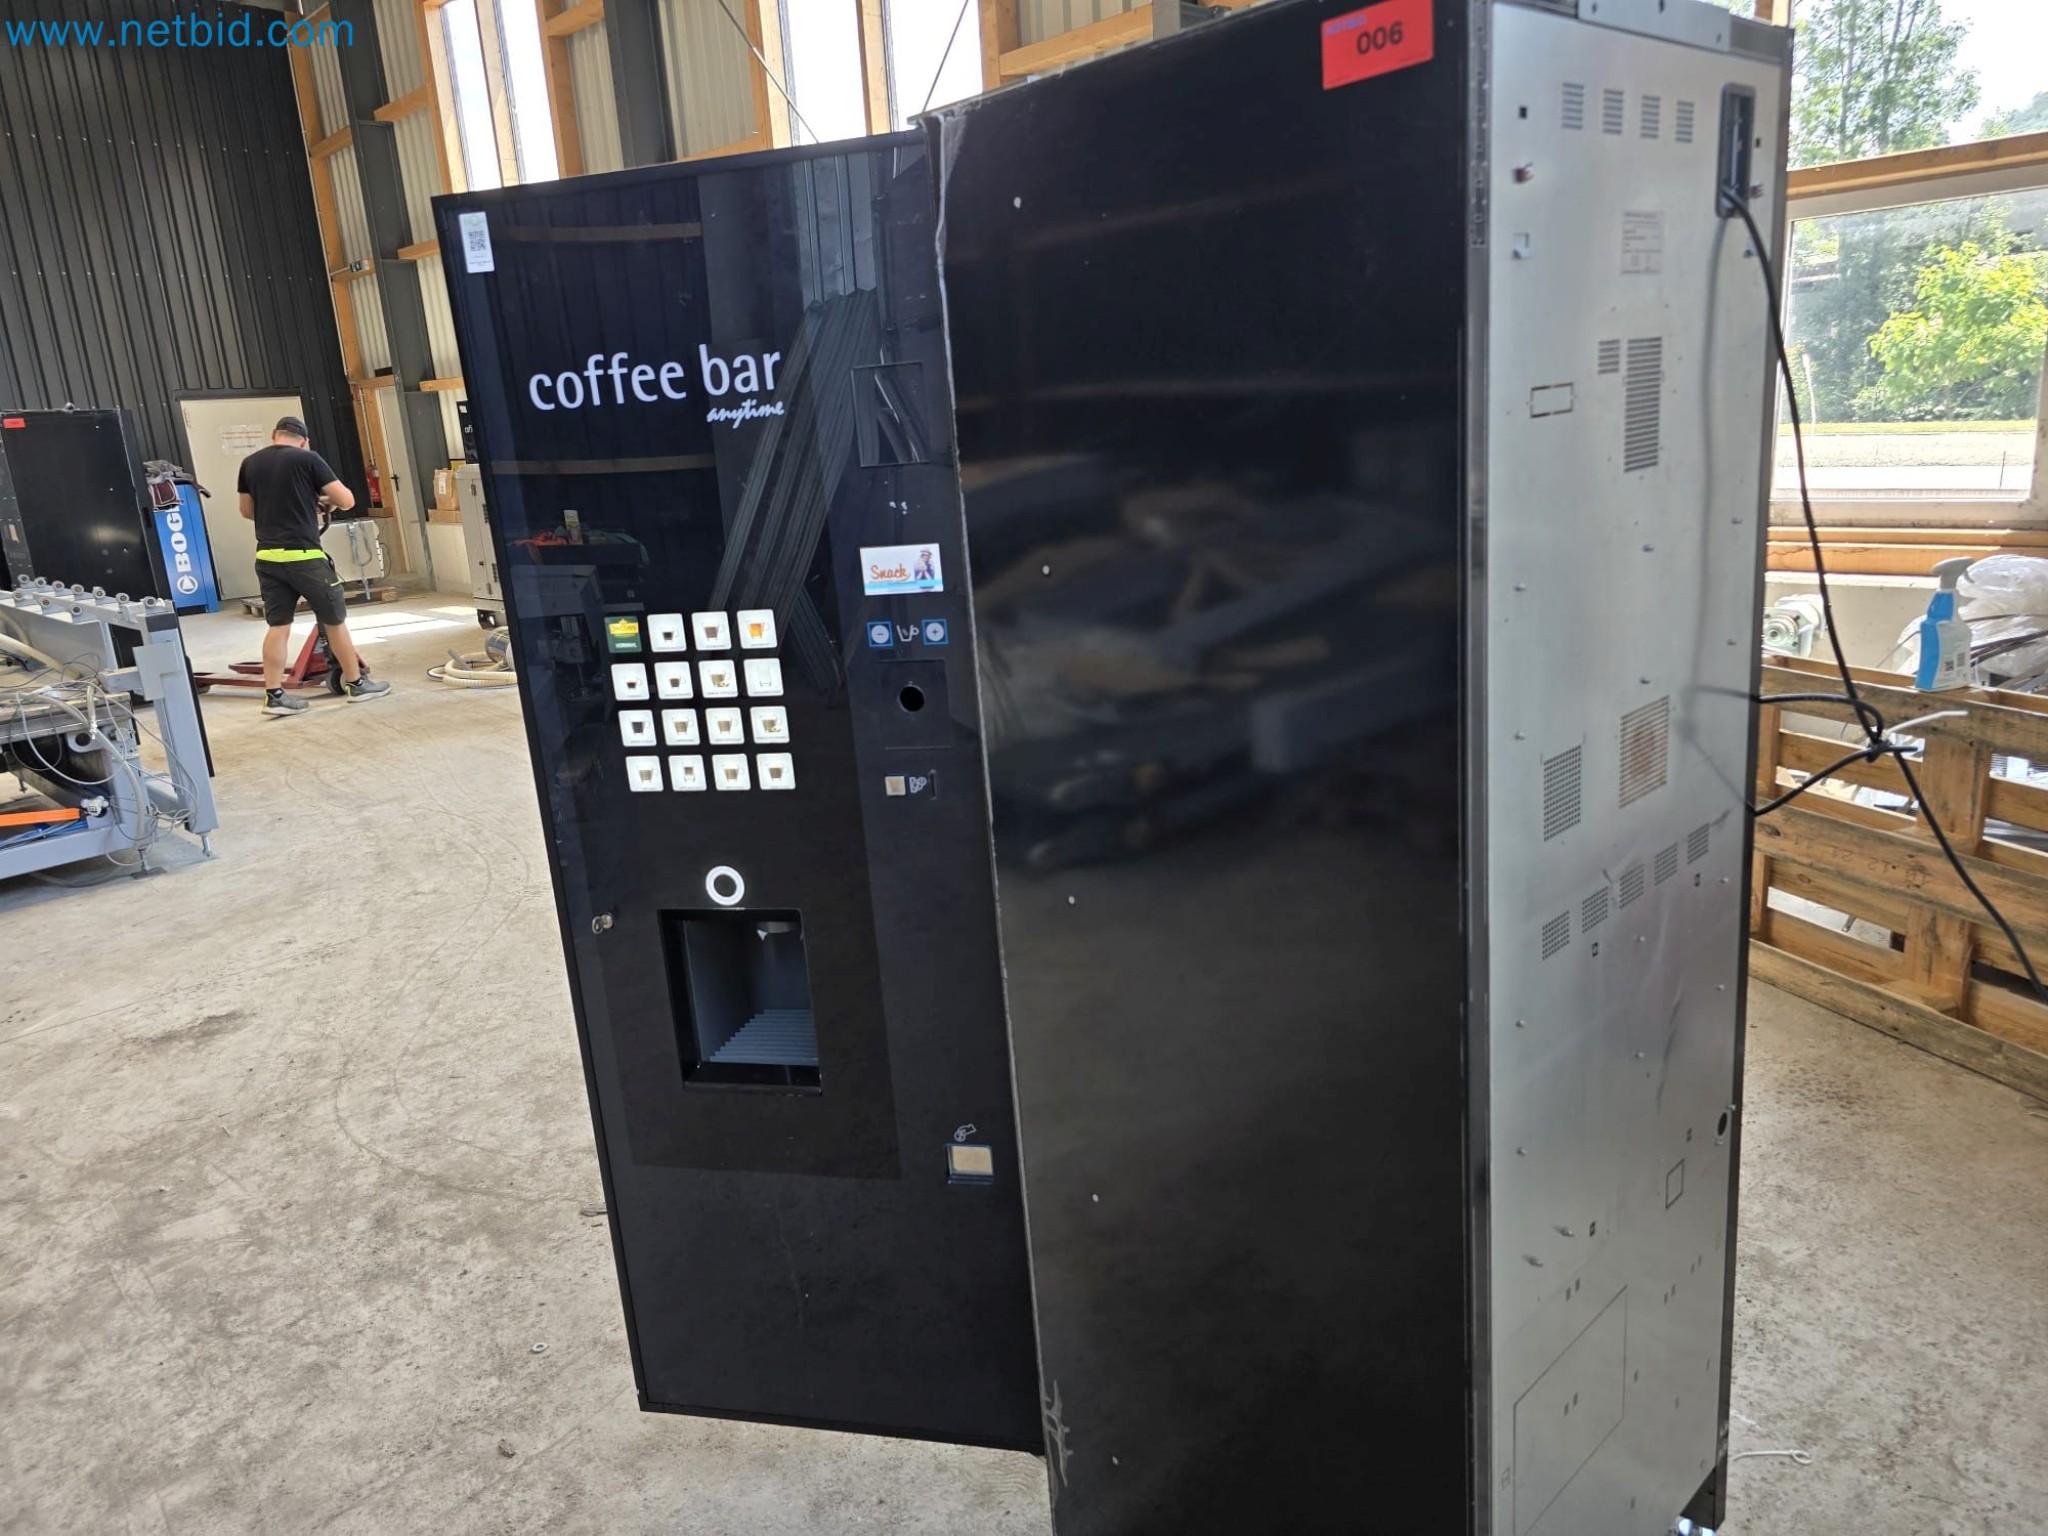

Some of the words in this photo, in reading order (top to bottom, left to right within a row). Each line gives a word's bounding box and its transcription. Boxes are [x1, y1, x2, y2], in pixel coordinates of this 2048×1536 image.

[1356, 20, 1403, 55] 006
[528, 352, 687, 411] coffee
[698, 343, 781, 396] bar
[706, 399, 785, 429] anytime
[869, 562, 911, 580] Snack
